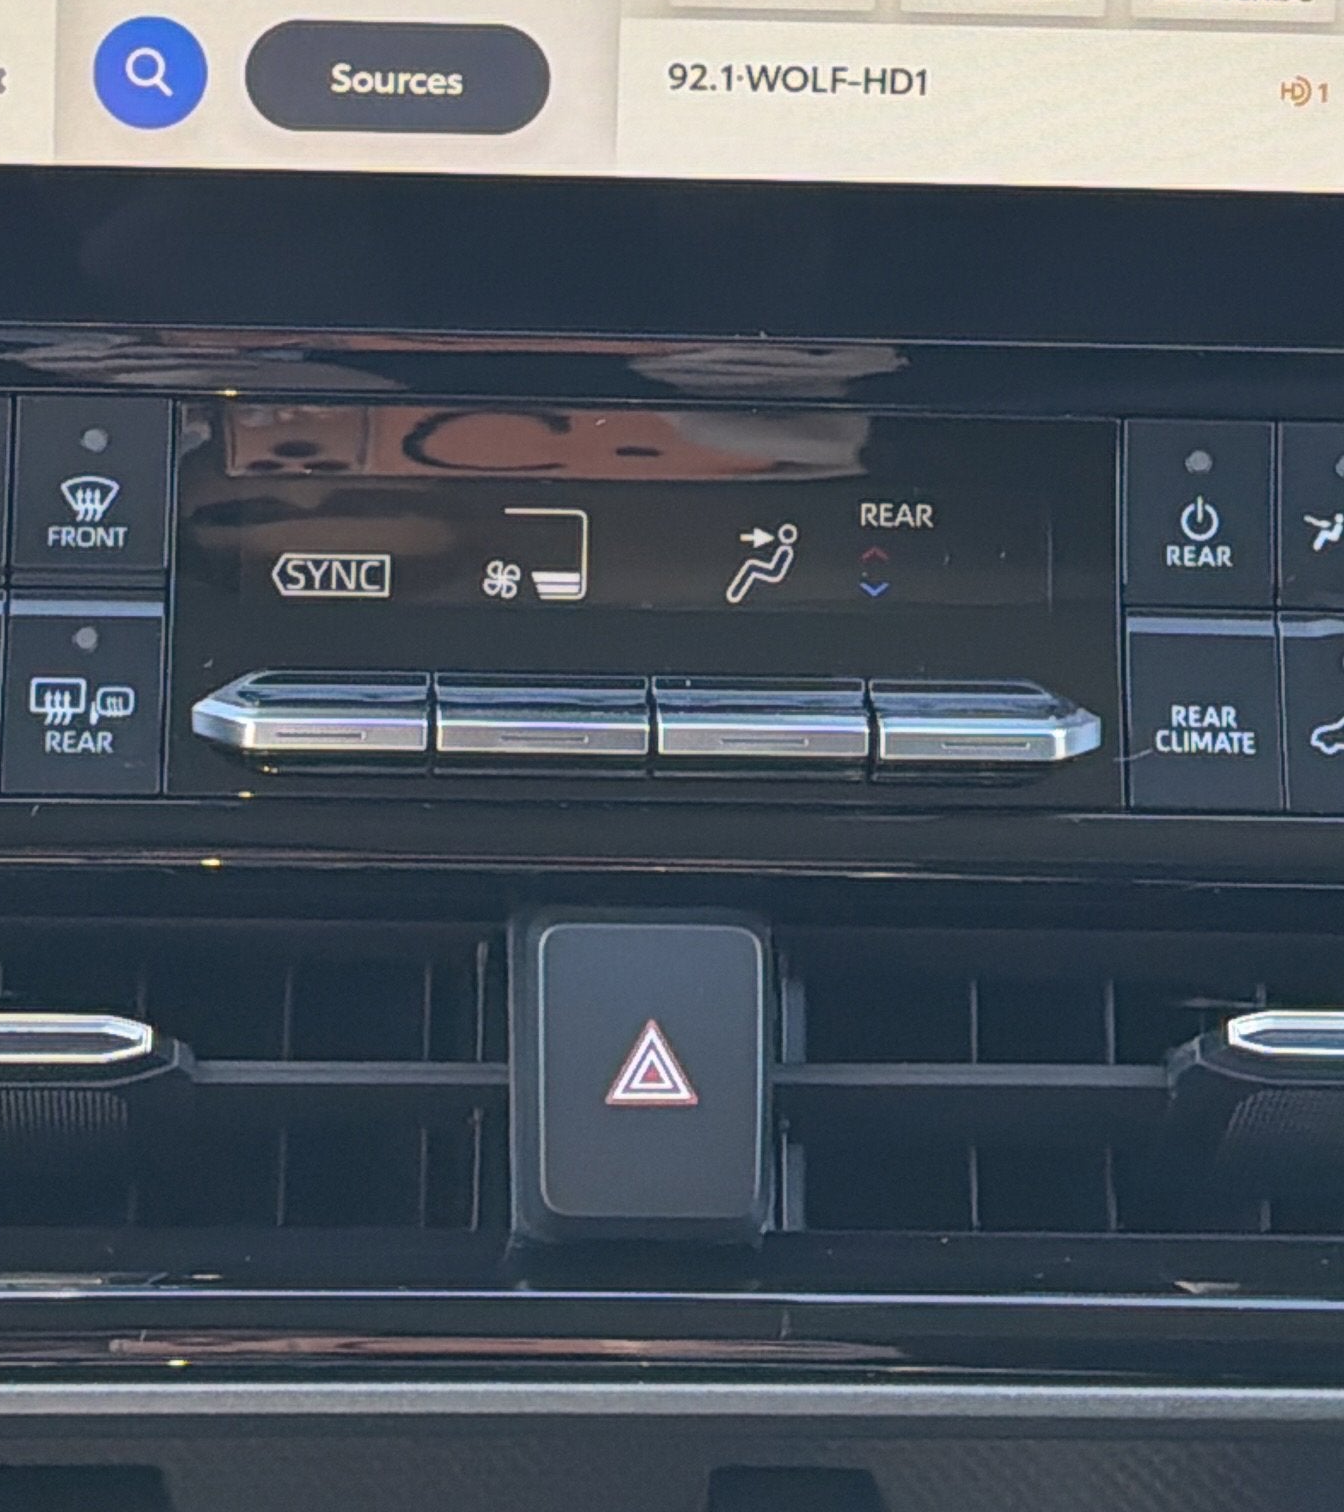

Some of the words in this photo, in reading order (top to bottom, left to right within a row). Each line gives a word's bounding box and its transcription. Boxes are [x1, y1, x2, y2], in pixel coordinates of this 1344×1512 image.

[331, 62, 463, 95] Sources
[860, 502, 933, 528] REAR
[48, 526, 127, 548] FRONT
[1166, 545, 1232, 567] REAR
[284, 559, 382, 592] SYNC
[1171, 705, 1237, 728] REAR
[45, 730, 113, 753] REAR
[1155, 730, 1255, 754] CLIMATE
